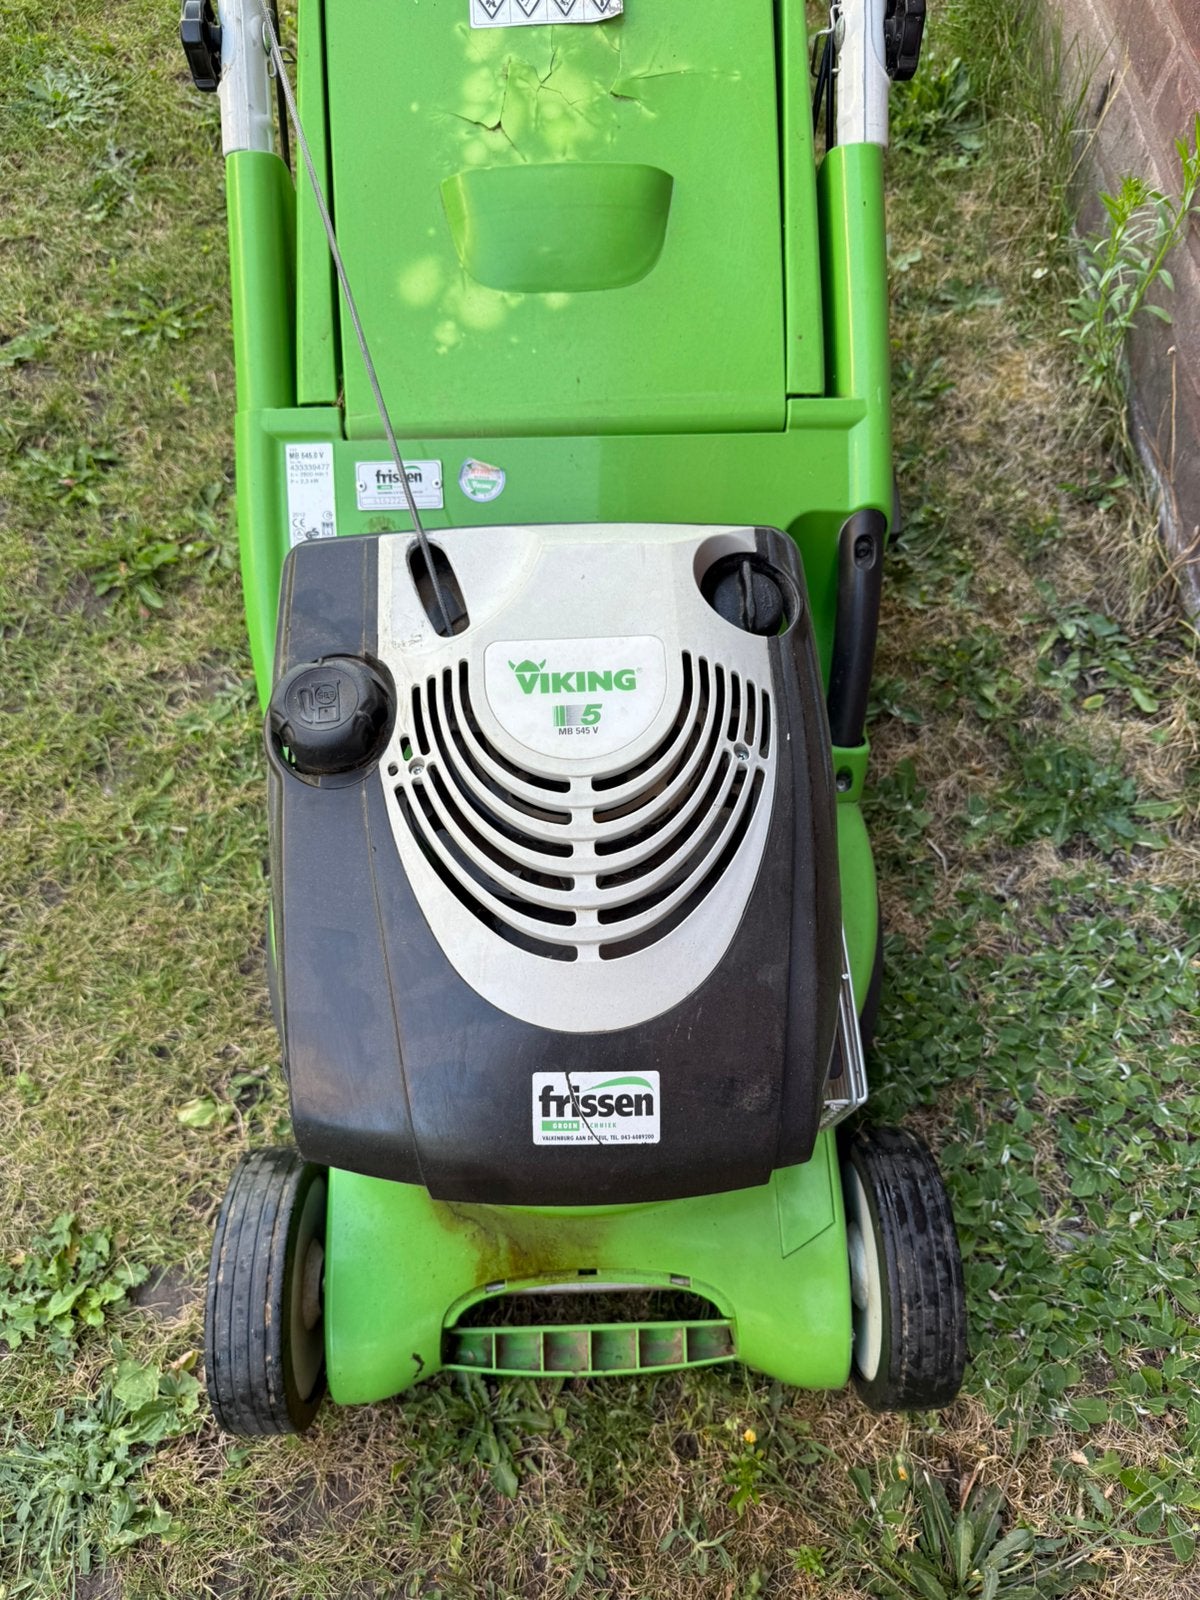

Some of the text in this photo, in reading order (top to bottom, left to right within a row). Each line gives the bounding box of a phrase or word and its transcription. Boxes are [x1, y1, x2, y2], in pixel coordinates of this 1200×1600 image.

[376, 469, 423, 484] frisen
[515, 669, 637, 694] VIKING
[581, 704, 603, 726] 5
[558, 726, 599, 736] MB 545 V
[539, 1085, 655, 1118] frissen
[552, 1122, 578, 1130] GROEN
